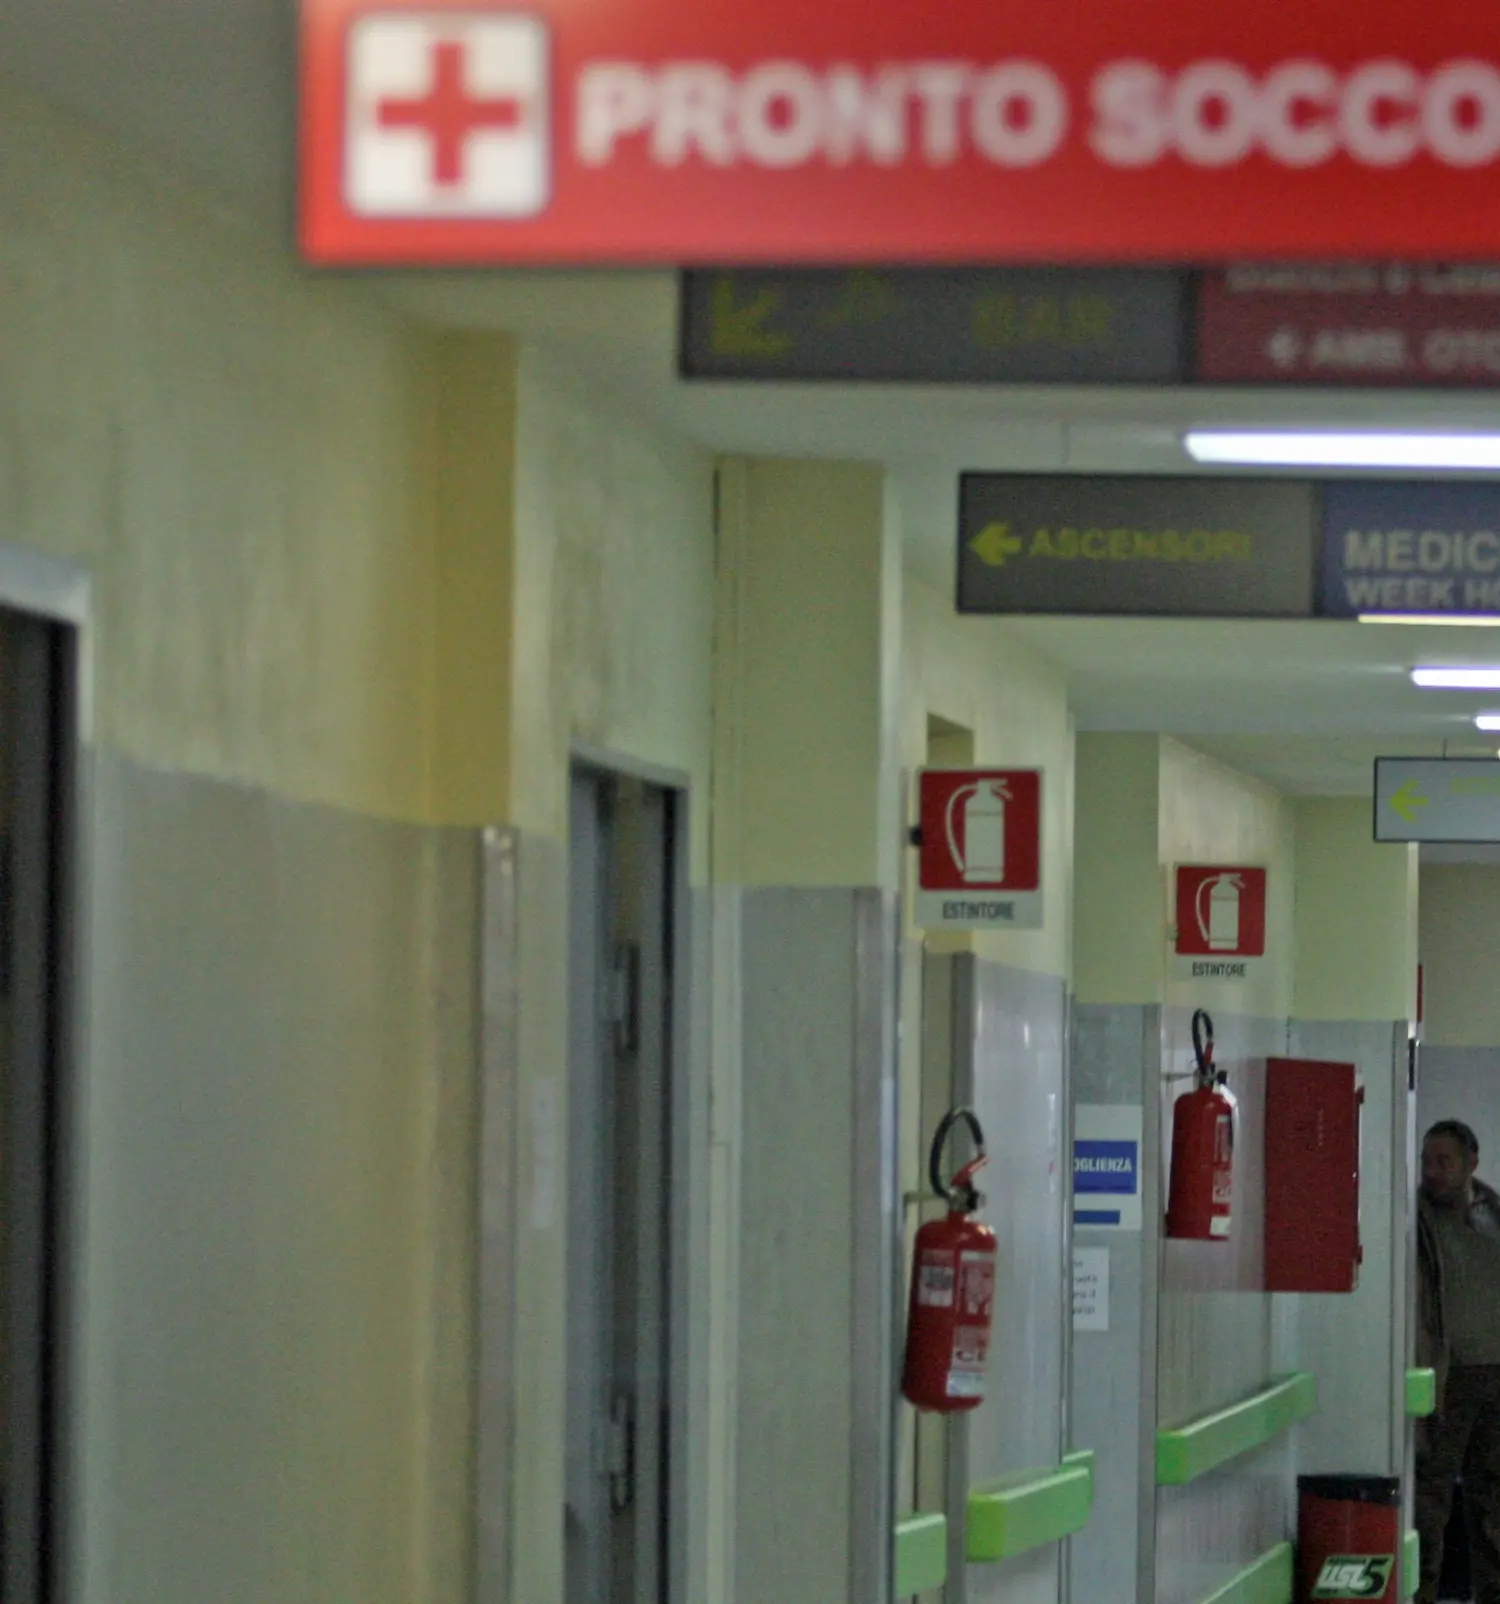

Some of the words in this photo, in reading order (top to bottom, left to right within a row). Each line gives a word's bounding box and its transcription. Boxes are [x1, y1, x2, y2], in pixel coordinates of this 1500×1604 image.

[575, 62, 1066, 168] PRONTO
[1029, 526, 1253, 562] ASCENSORI
[1345, 579, 1454, 609] WEEK
[942, 900, 1015, 920] ESTINTORE
[1192, 961, 1246, 978] ESTINTORE
